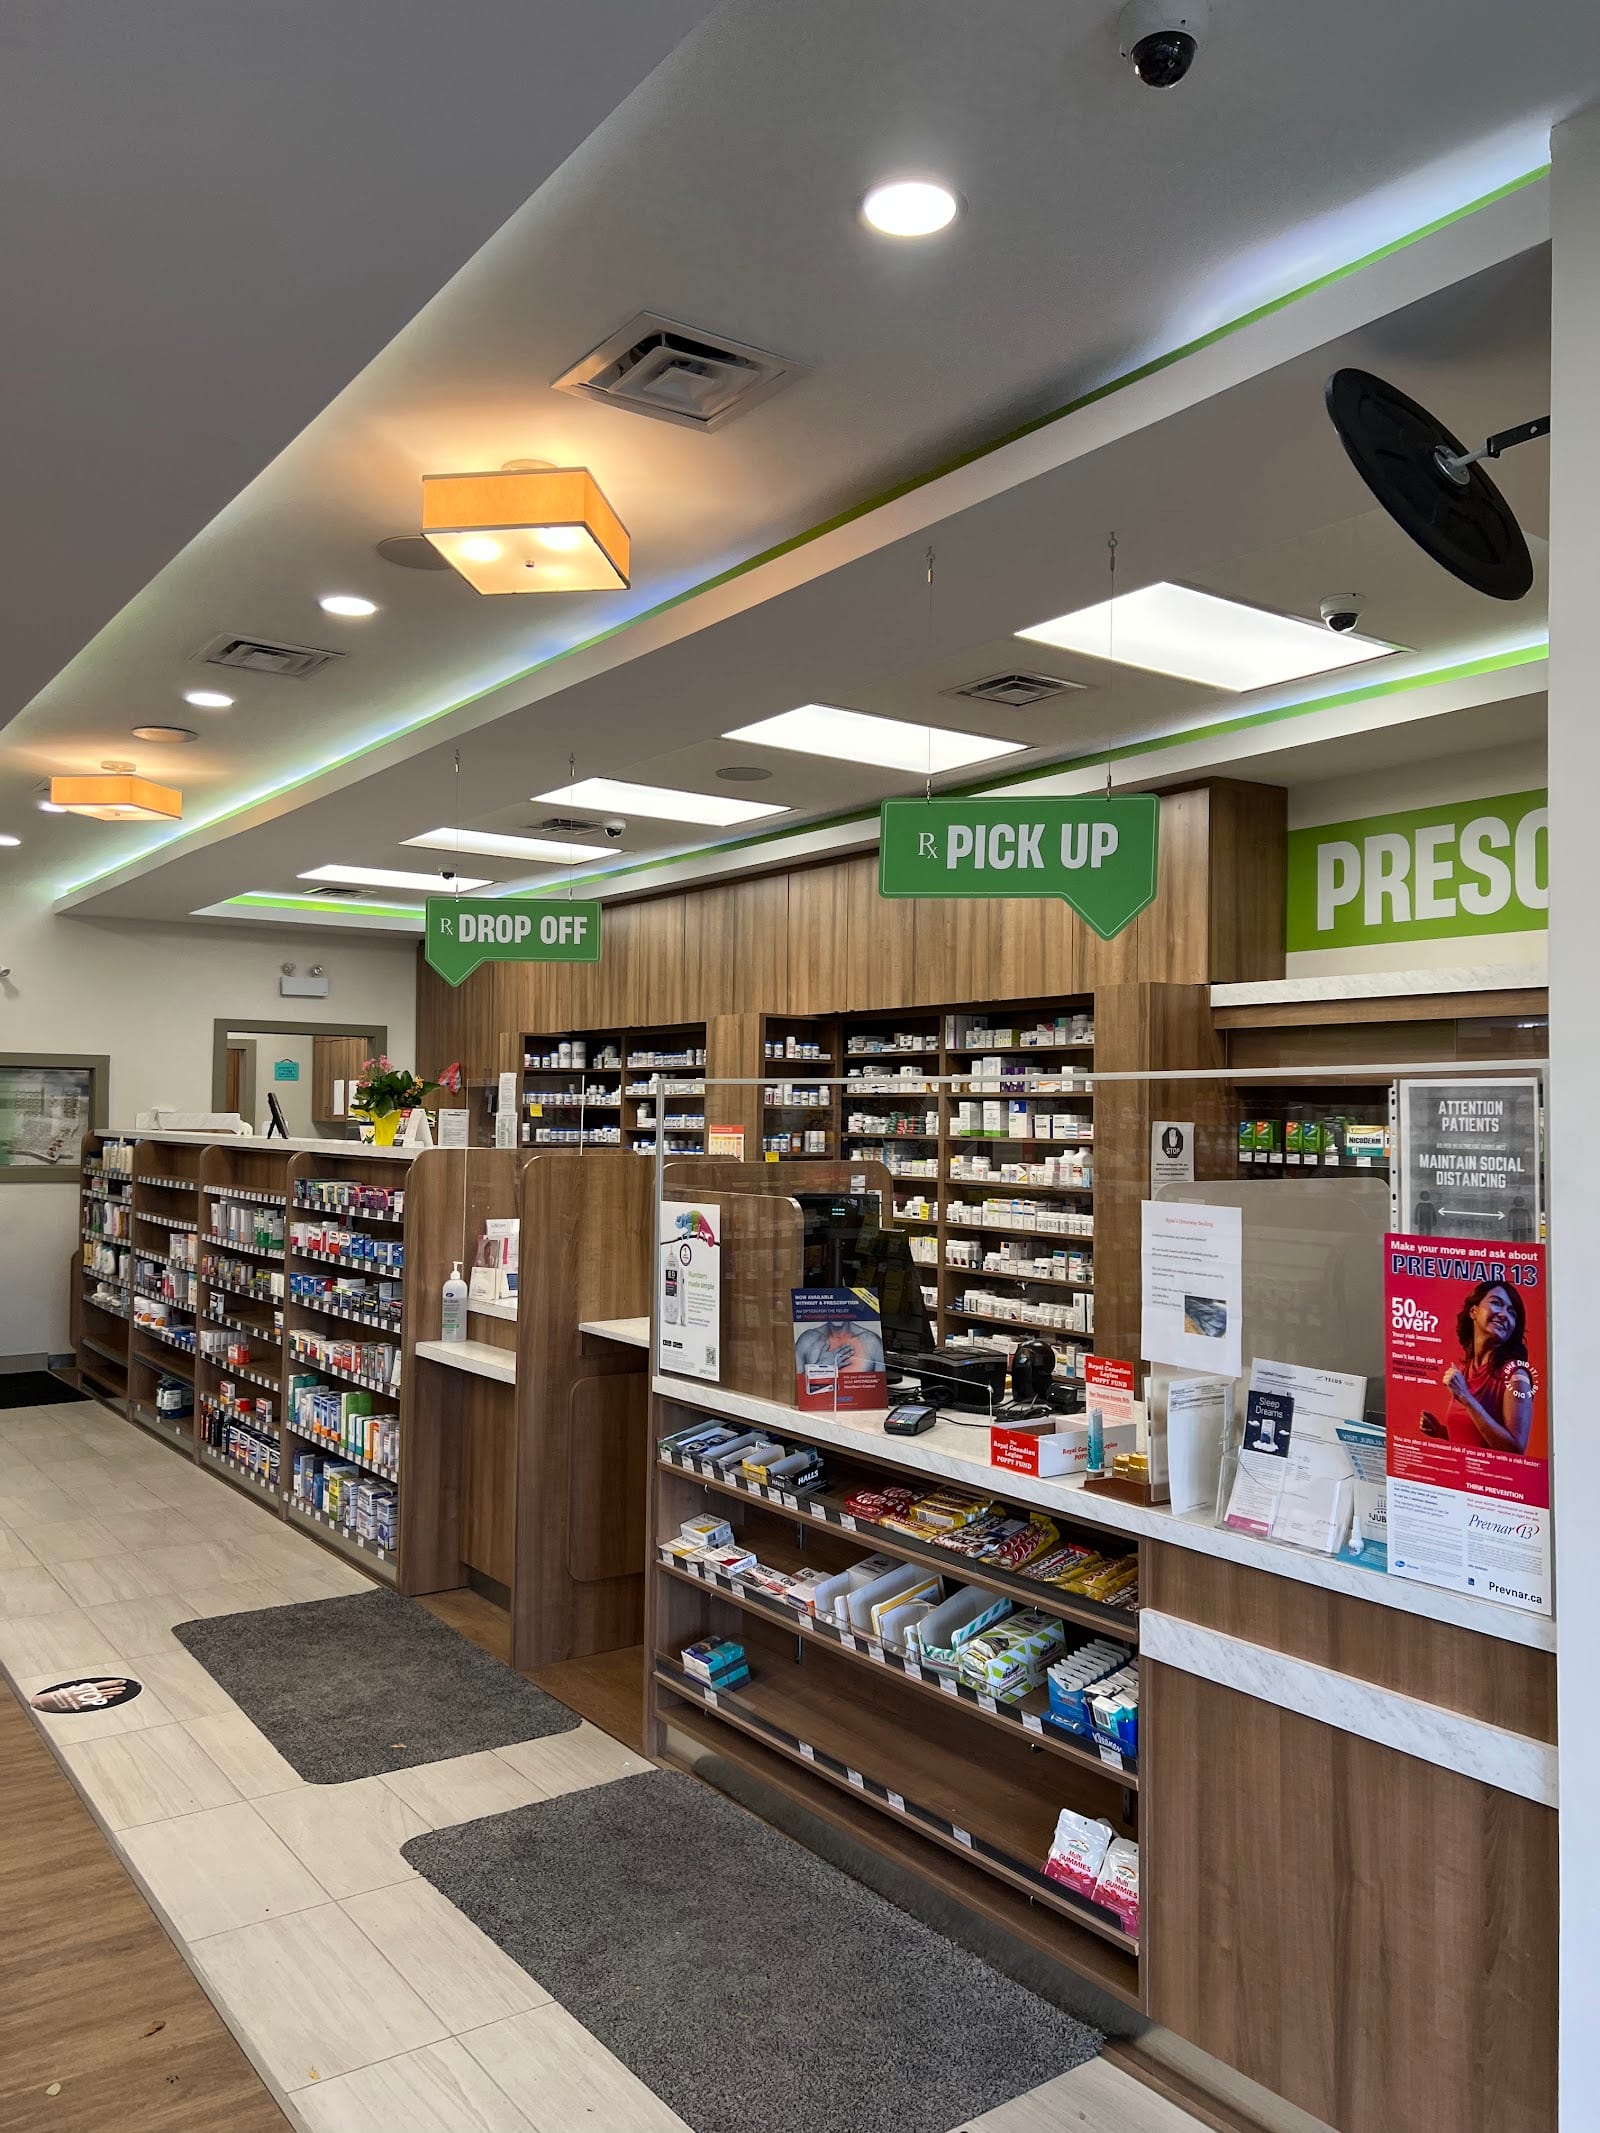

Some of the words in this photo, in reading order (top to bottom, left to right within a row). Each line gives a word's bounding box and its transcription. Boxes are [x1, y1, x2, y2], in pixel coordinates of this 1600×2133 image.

[947, 824, 1045, 869] PICK
[1061, 823, 1119, 869] UP
[459, 914, 532, 943] DROP
[540, 916, 588, 944] OFF
[1438, 1100, 1503, 1116] ATTENTION
[1441, 1117, 1500, 1132] PATIENTS
[1166, 1147, 1180, 1155] STOP
[1419, 1154, 1477, 1170] MAINTAIN
[1480, 1156, 1525, 1172] SOCIAL
[1436, 1171, 1506, 1188] DISTANCING
[1391, 1241, 1415, 1252] Make
[1418, 1243, 1438, 1254] your
[1440, 1246, 1466, 1256] move
[1468, 1248, 1487, 1257] and
[1489, 1249, 1506, 1259] ask
[1508, 1251, 1538, 1261] about
[1392, 1254, 1506, 1283] PREVNAR
[1510, 1265, 1538, 1287] 13
[1392, 1297, 1416, 1318] 50
[1416, 1310, 1429, 1319] or
[1392, 1315, 1439, 1333] over?
[1392, 1352, 1407, 1360] Don't
[1088, 1362, 1104, 1370] Royal
[1104, 1366, 1131, 1375] Canadian
[1100, 1371, 1119, 1379] Legion
[1504, 1361, 1517, 1375] SHE
[1517, 1360, 1530, 1369] DID
[1092, 1376, 1110, 1385] POPPY
[1110, 1380, 1128, 1388] FUND
[1325, 1377, 1342, 1385] TELUS
[1513, 1390, 1526, 1399] DID
[1526, 1384, 1539, 1398] SHE
[1259, 1397, 1280, 1409] Sleep
[1255, 1405, 1284, 1418] Dreams
[993, 1440, 1009, 1450] Royal
[1009, 1445, 1036, 1457] Canadian
[1004, 1450, 1023, 1460] Legion
[996, 1456, 1014, 1466] POPPY
[1015, 1460, 1032, 1470] FUND
[1496, 1454, 1508, 1462] with
[1513, 1457, 1523, 1465] risk
[771, 1479, 785, 1488] HALLS
[798, 1470, 819, 1485] HALLS
[1466, 1482, 1484, 1492] THINK
[1485, 1486, 1524, 1500] PREVENTION
[1468, 1514, 1515, 1536] Prevnar
[1489, 1581, 1543, 1605] Prevnar.ca
[1068, 1850, 1083, 1860] Multi
[1058, 1853, 1092, 1873] GUMMIES
[1105, 1879, 1138, 1899] GUMMIES
[1115, 1876, 1130, 1887] Multi
